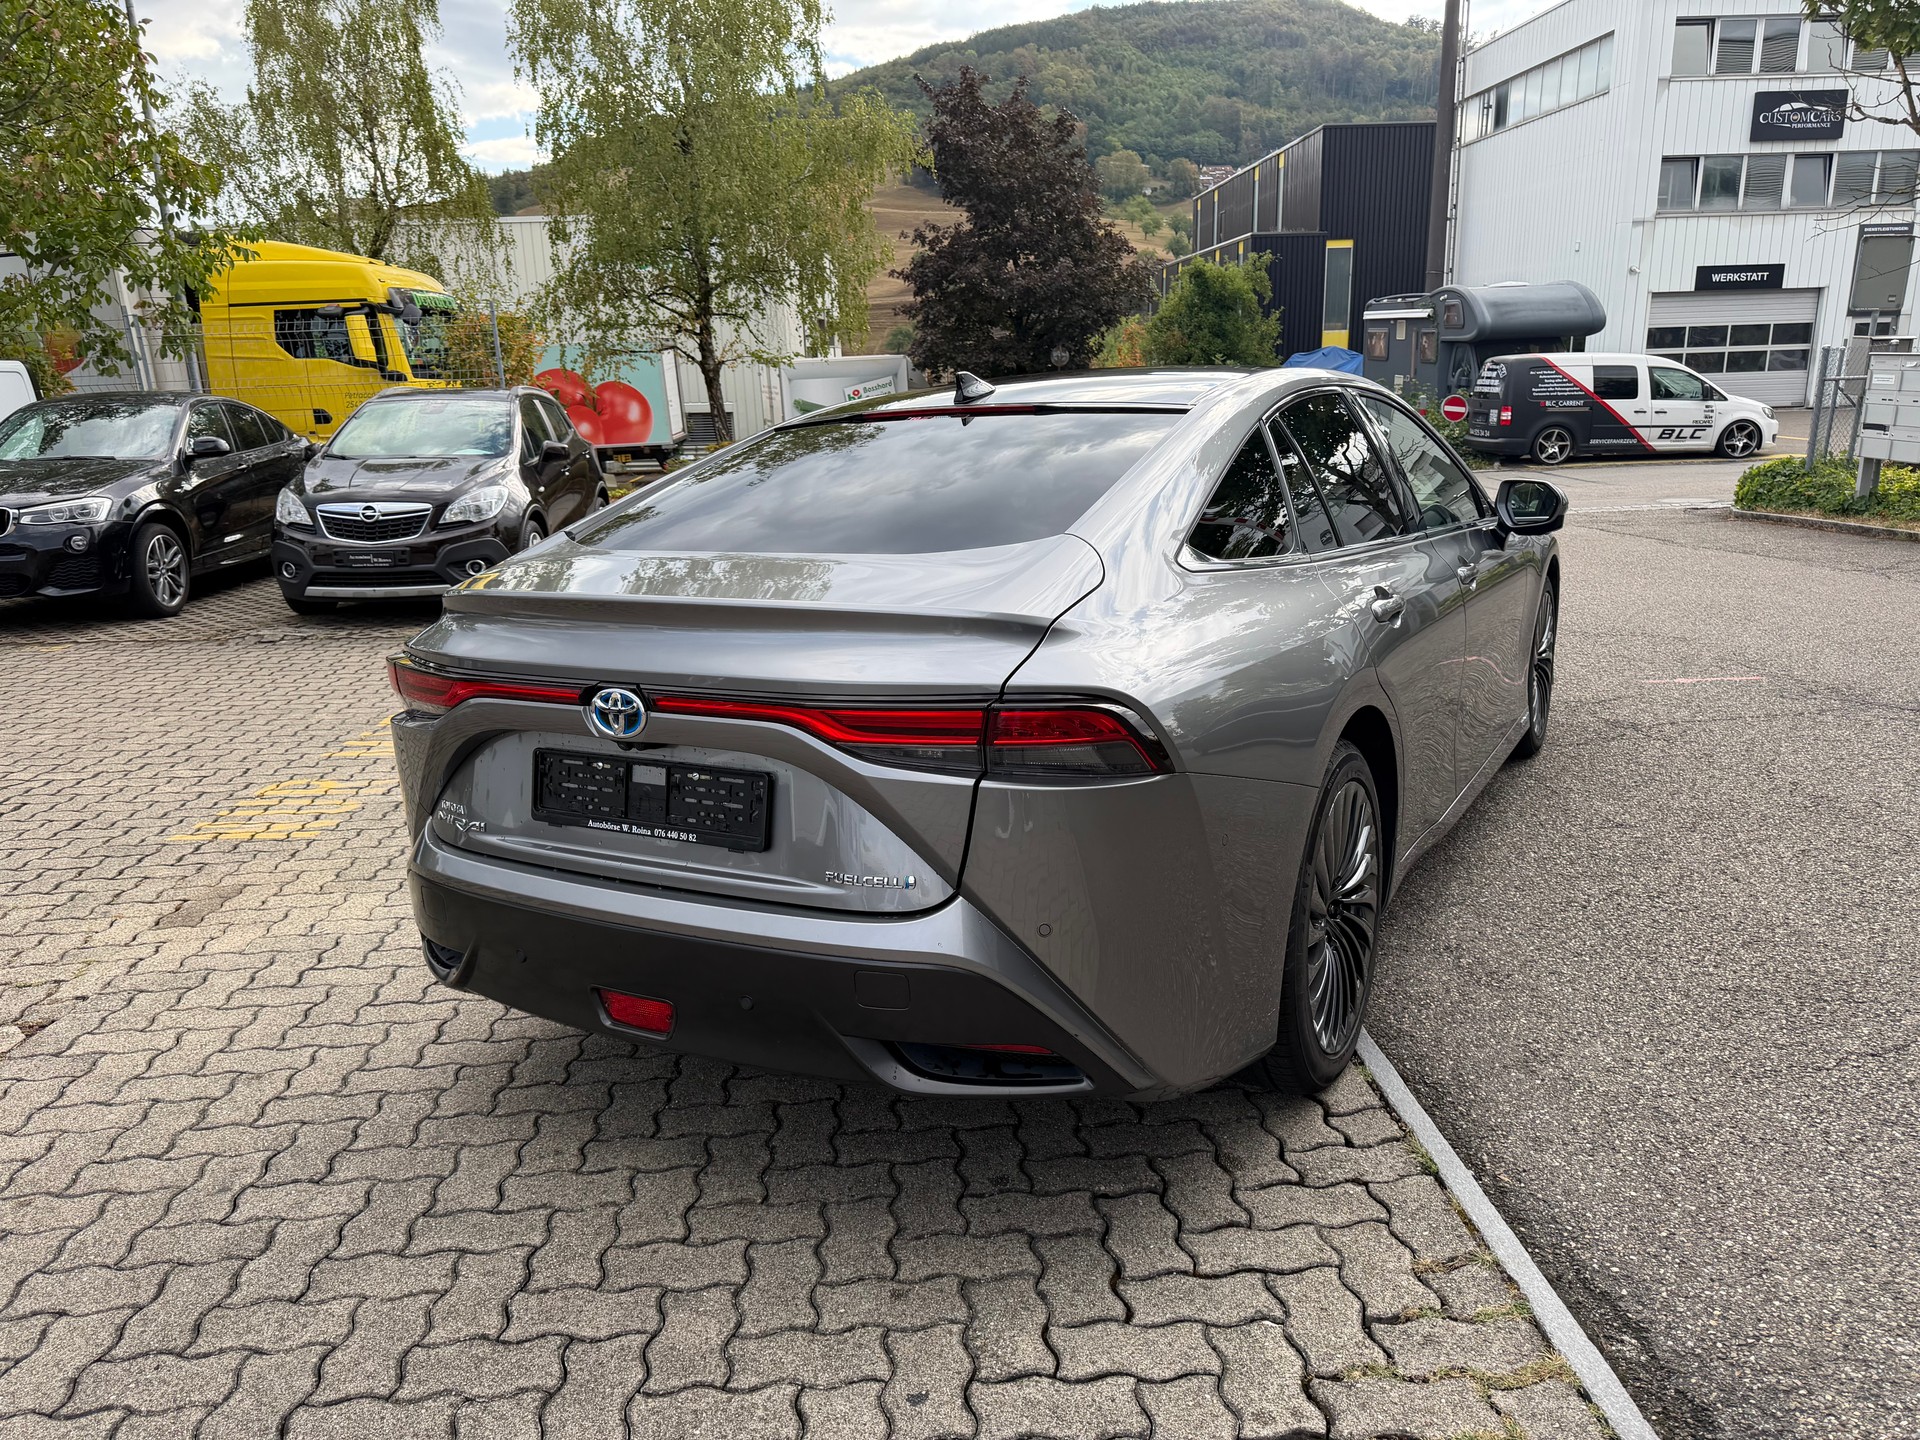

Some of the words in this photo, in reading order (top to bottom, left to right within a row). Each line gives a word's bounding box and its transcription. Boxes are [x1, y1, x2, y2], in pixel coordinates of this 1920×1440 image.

[1711, 272, 1769, 282] WERKSTATT
[863, 380, 893, 394] Bosshard
[1657, 428, 1707, 440] BLC
[587, 819, 621, 831] Autobörse
[621, 823, 631, 833] W.
[654, 828, 666, 838] 076
[667, 830, 679, 840] 440
[680, 832, 688, 840] 50
[688, 833, 697, 842] 82
